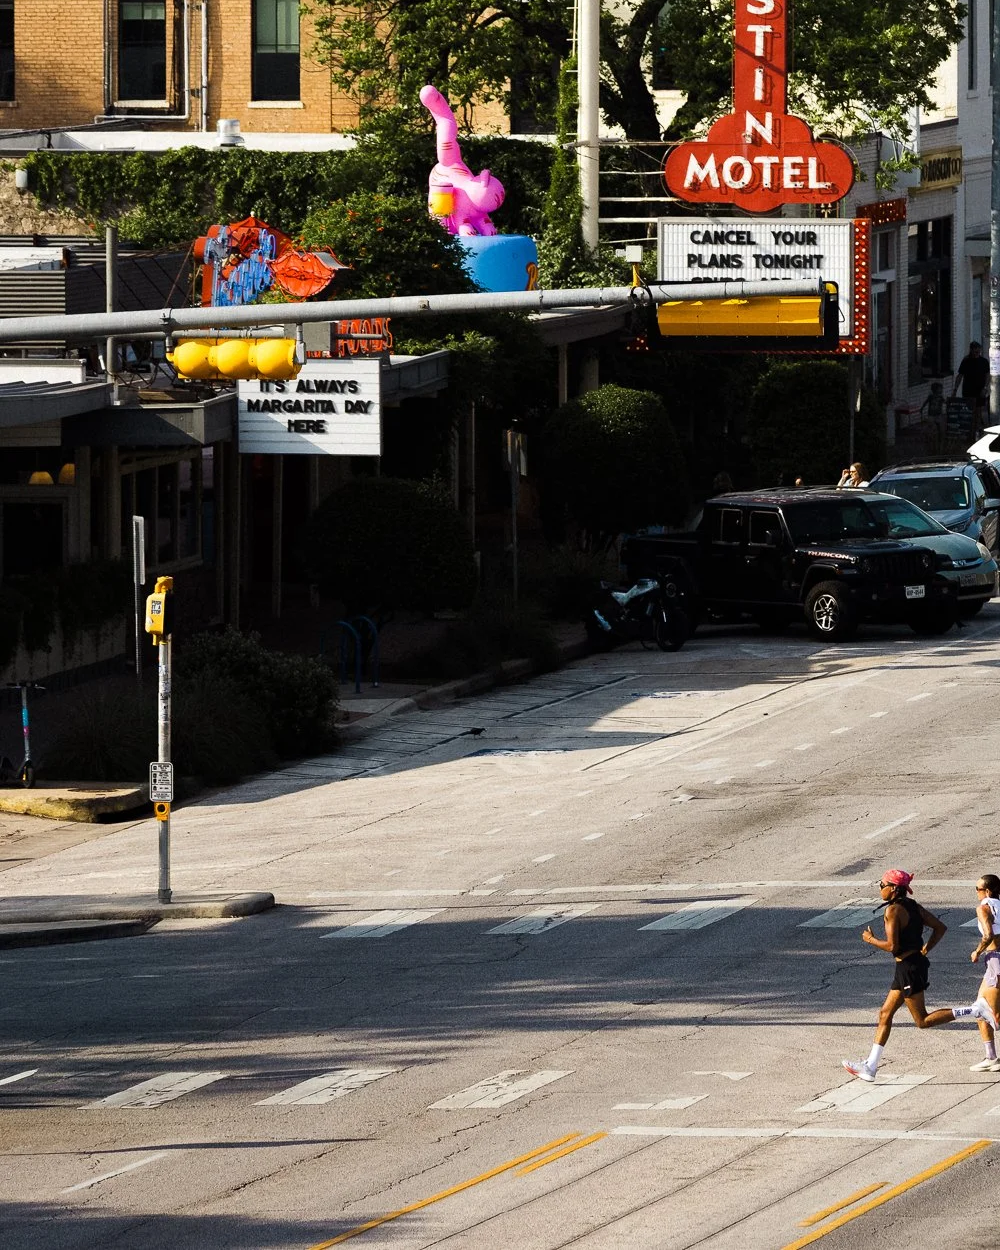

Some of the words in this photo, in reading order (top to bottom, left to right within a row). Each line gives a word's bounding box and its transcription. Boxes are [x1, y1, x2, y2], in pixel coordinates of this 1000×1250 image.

[683, 152, 832, 189] MOTEL
[690, 230, 756, 246] CANCEL
[771, 230, 818, 246] YOUR
[687, 253, 743, 269] PLANS
[752, 253, 824, 269] TONIGHT
[295, 379, 359, 394] ALWAYS
[247, 399, 336, 414] MARGARITA
[344, 400, 373, 414] DAY
[287, 419, 327, 433] HERE
[808, 551, 849, 559] RUBICON
